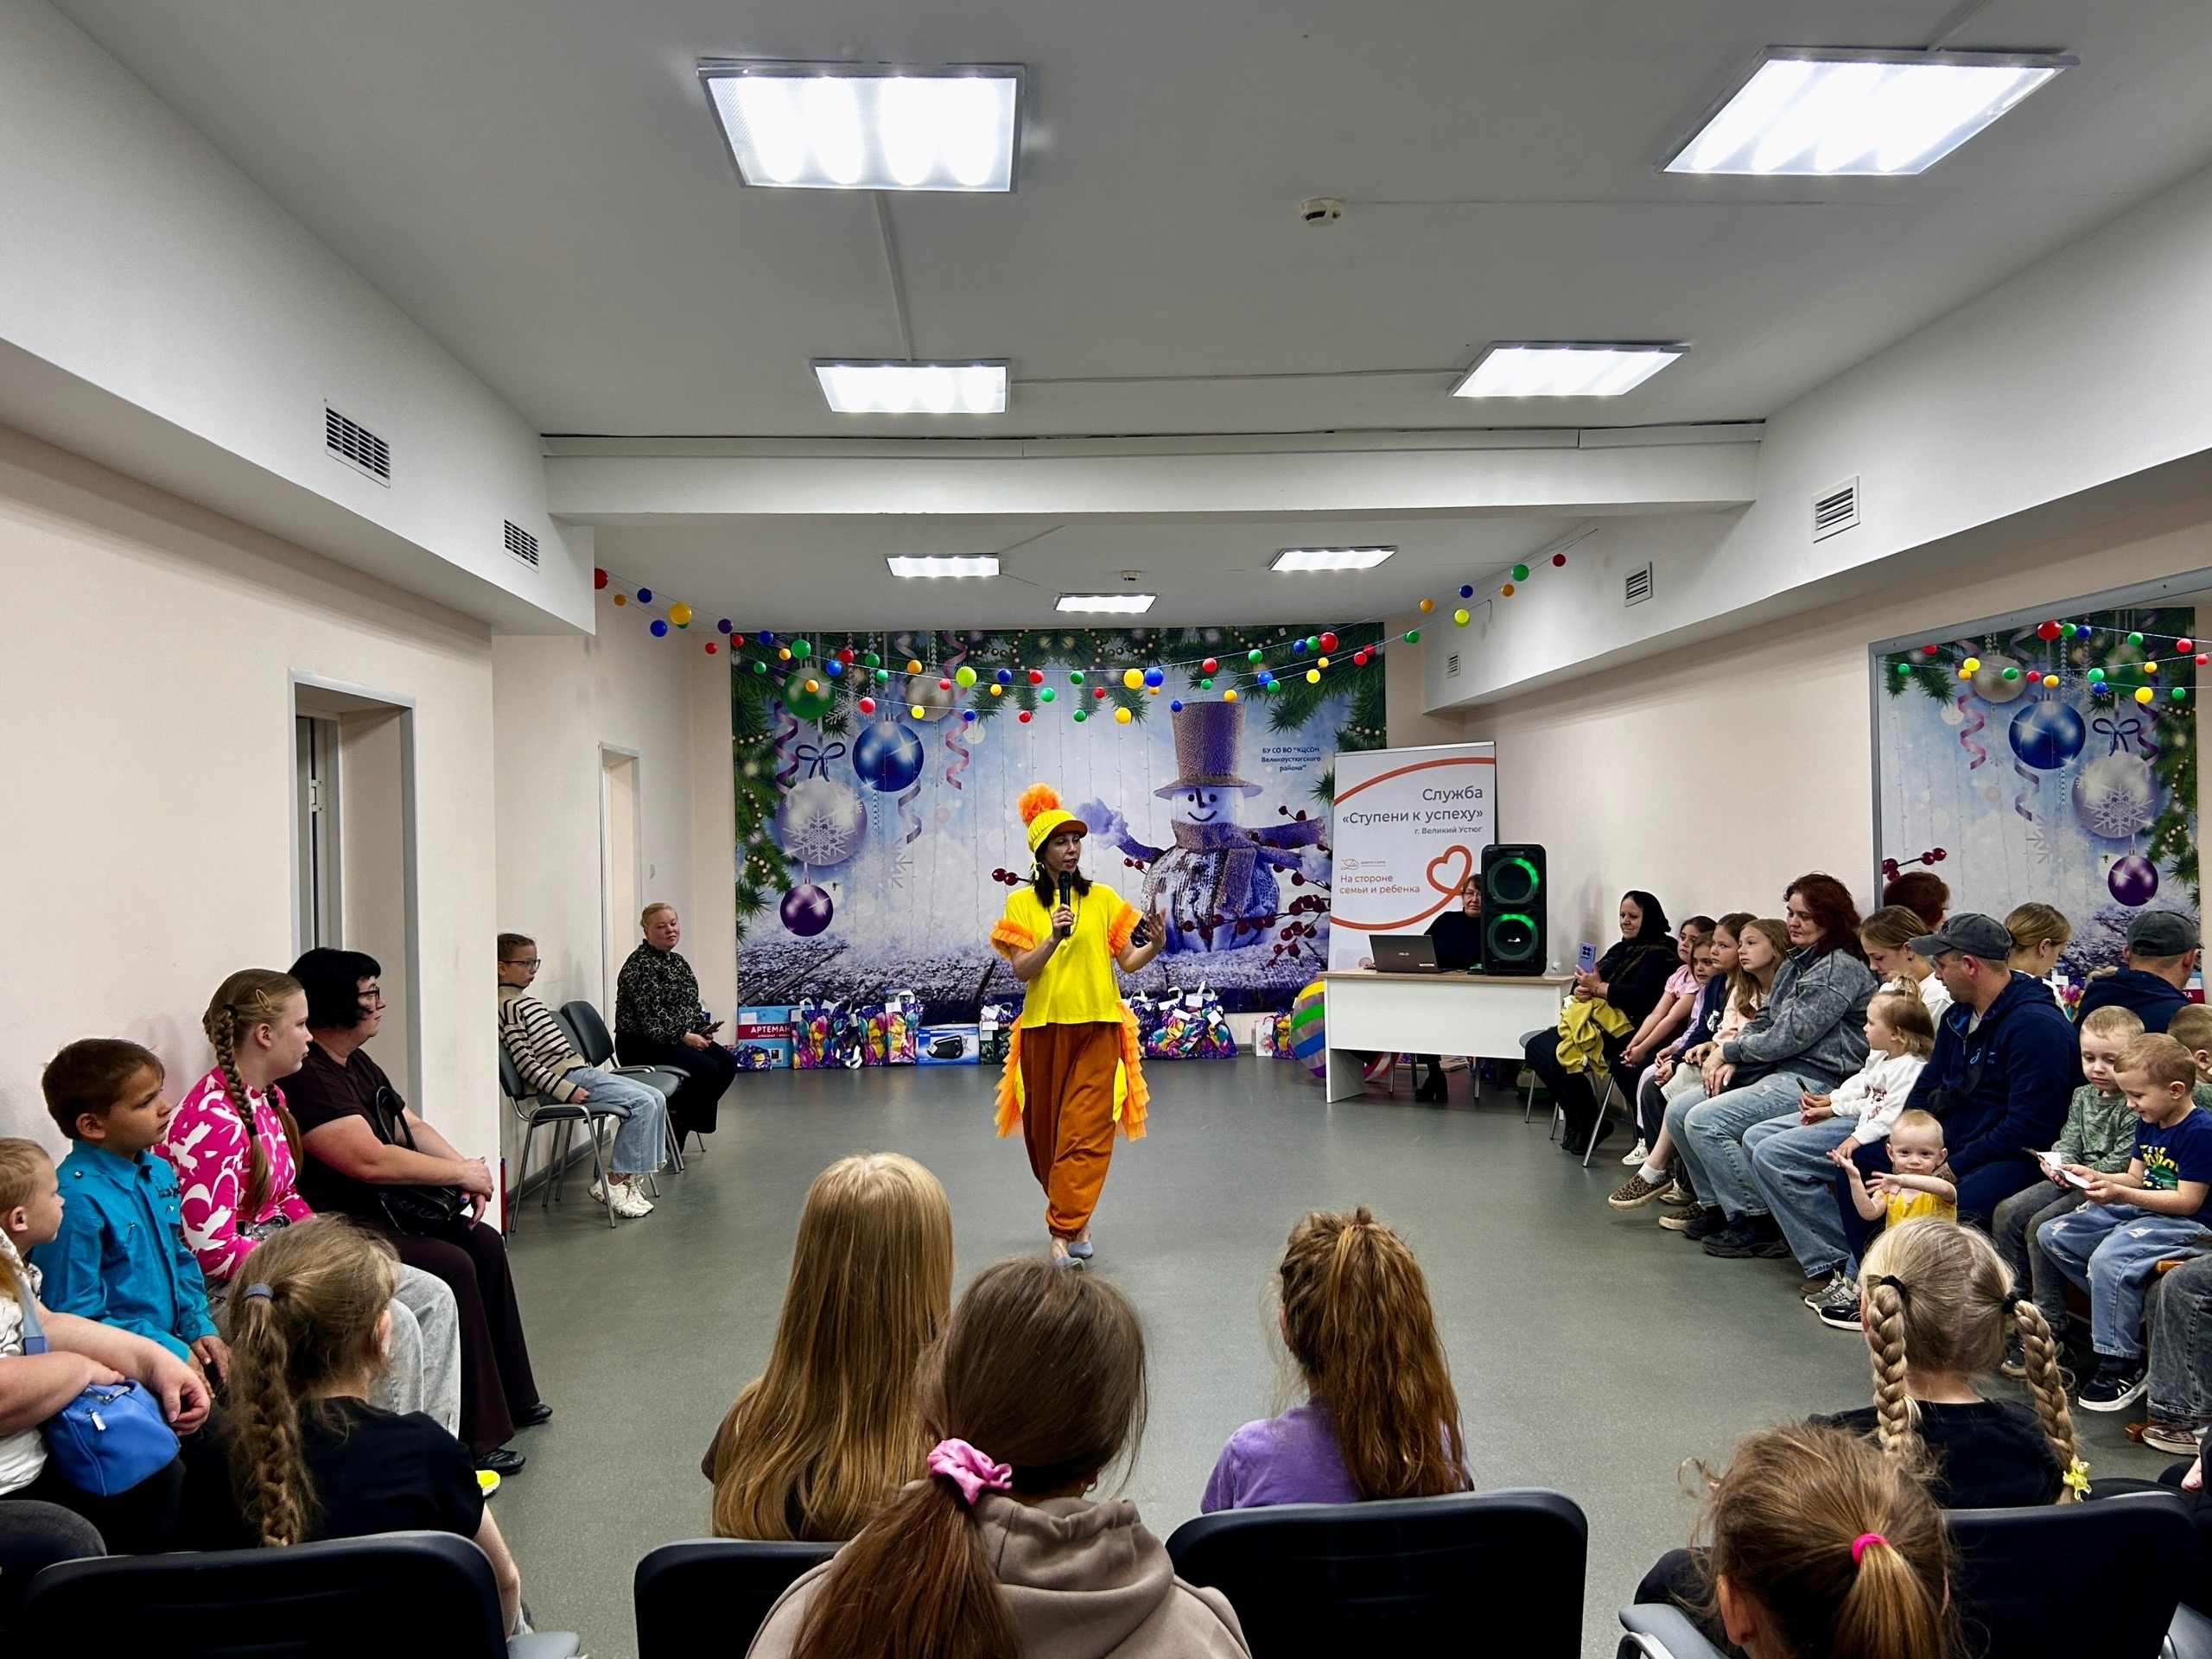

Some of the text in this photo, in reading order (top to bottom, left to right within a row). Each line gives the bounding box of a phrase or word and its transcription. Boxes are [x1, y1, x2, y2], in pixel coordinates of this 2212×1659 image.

[1422, 785, 1483, 803] Служба
[1342, 809, 1484, 825] «Ступени к успеху»
[1354, 875, 1394, 884] стороне
[1379, 885, 1421, 895] ребенка
